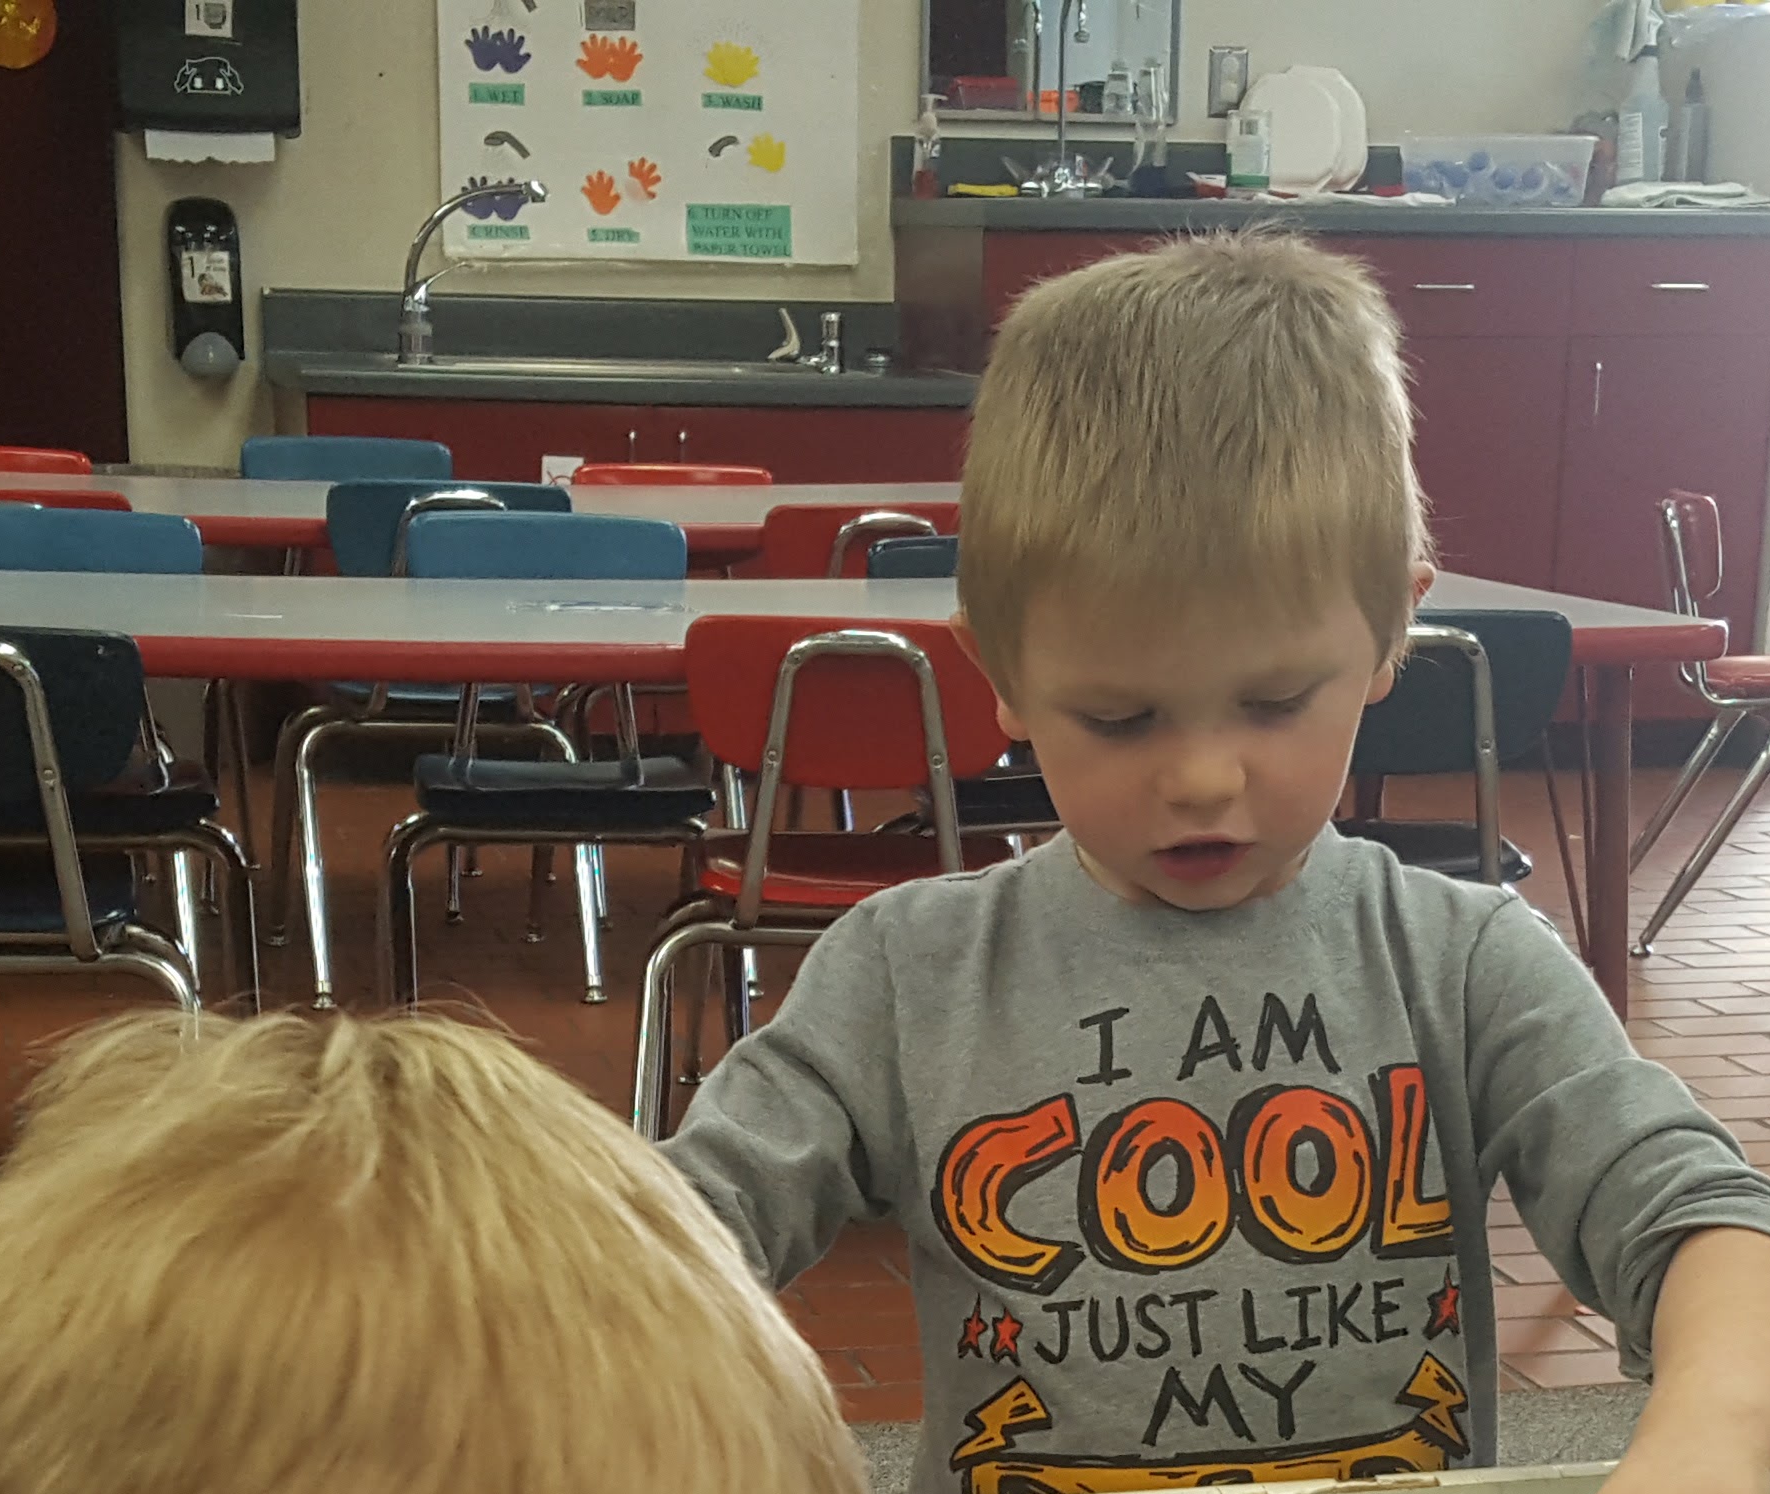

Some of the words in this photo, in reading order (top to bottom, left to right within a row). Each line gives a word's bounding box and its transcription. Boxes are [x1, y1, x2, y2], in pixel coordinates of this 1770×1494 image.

[488, 89, 520, 104] WET
[601, 92, 640, 106] SOAP
[719, 95, 762, 110] WASH
[702, 206, 742, 220] TURN
[745, 207, 773, 221] OFF
[605, 229, 637, 242] DRY
[691, 225, 740, 239] WATER
[744, 225, 783, 240] WITH
[692, 242, 736, 255] PAPER
[740, 243, 791, 257] TOWEL
[1077, 1006, 1132, 1085] I
[1176, 993, 1342, 1081] AM
[931, 1062, 1454, 1295] COOL
[1033, 1288, 1219, 1364] JUST
[1241, 1278, 1408, 1355] LIKE
[1141, 1358, 1316, 1445] MY
